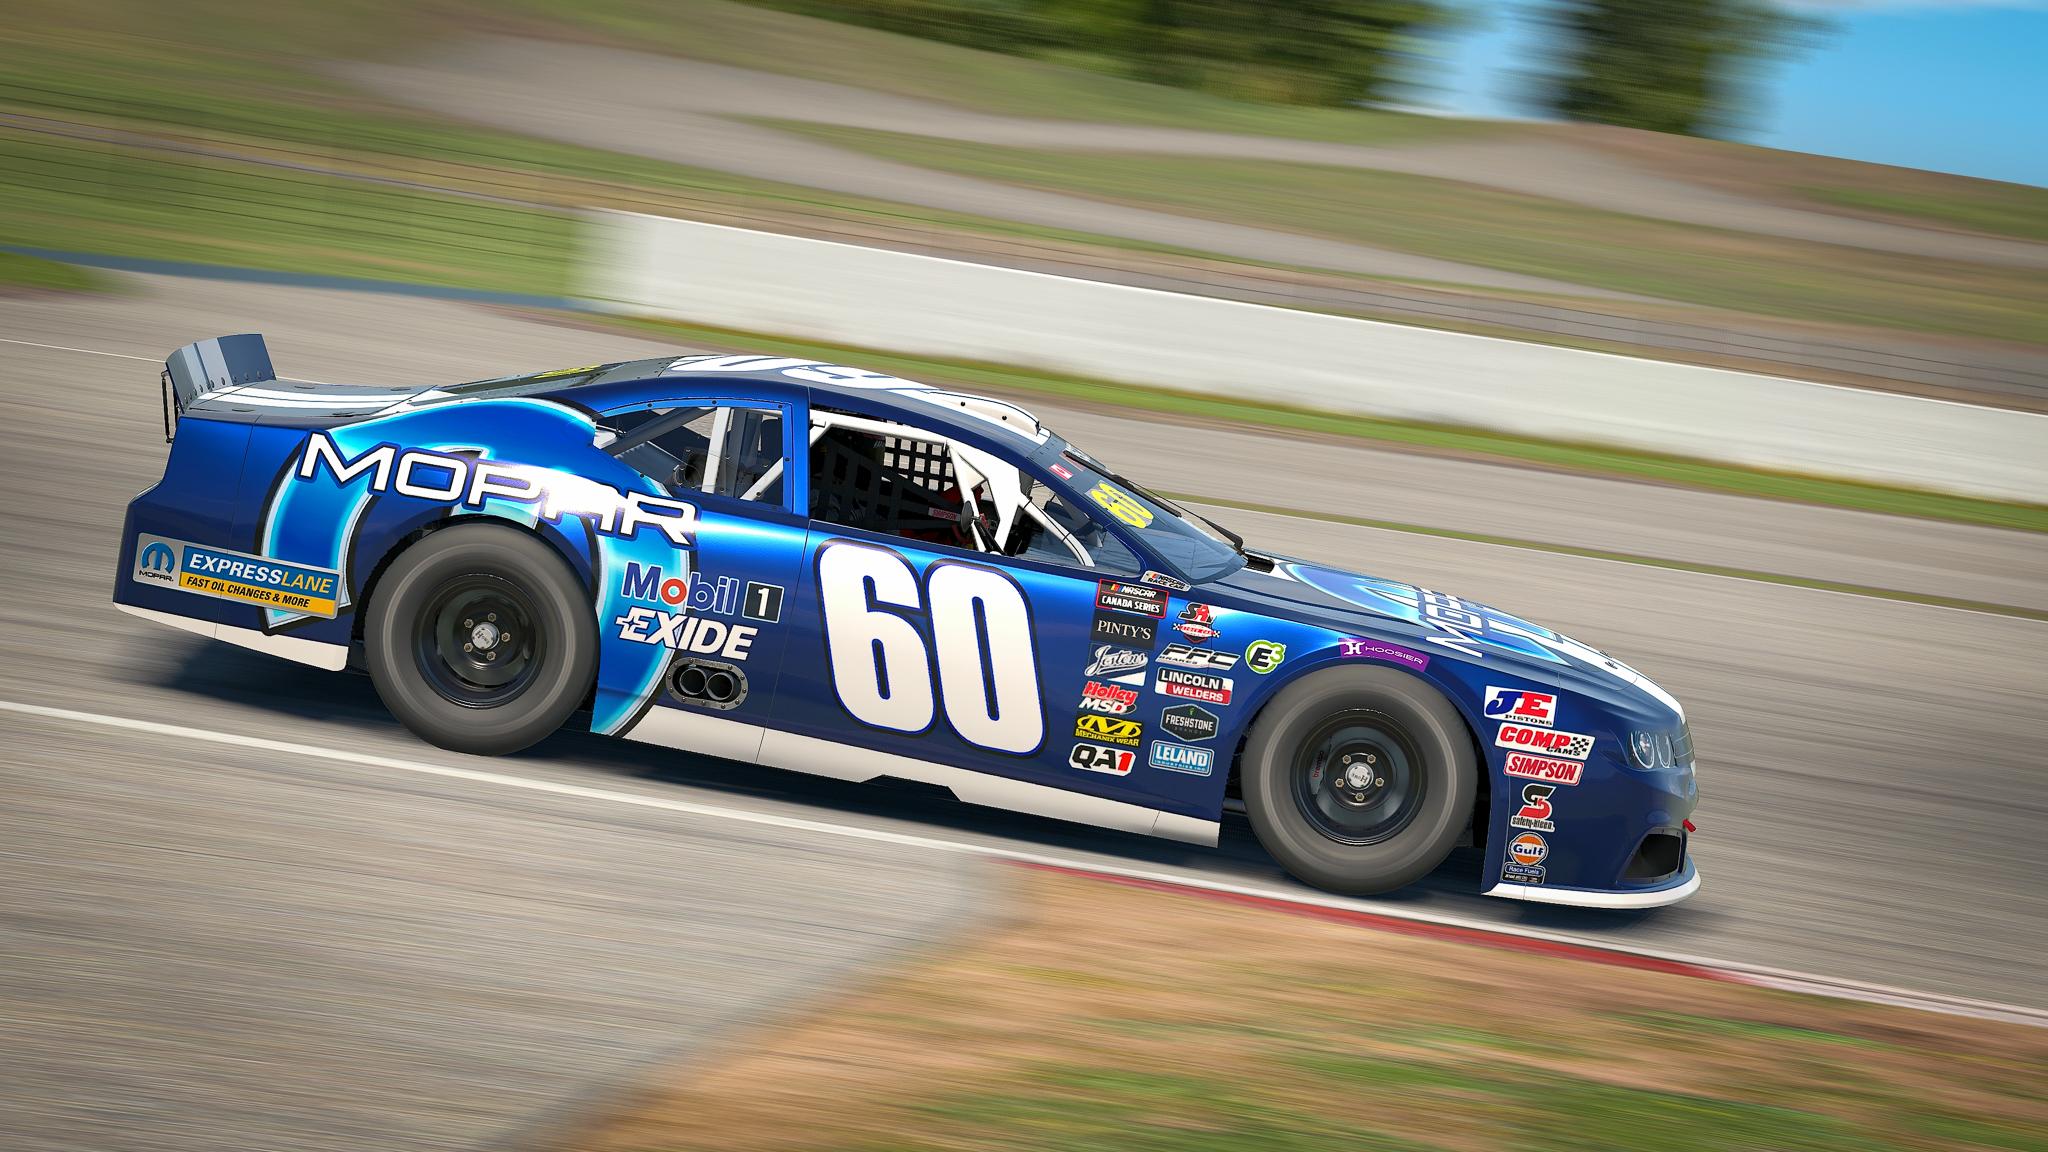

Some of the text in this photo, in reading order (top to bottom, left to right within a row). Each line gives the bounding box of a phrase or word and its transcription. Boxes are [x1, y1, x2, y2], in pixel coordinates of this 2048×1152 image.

[299, 432, 698, 545] MOPAR
[1090, 483, 1154, 529] 60
[139, 569, 175, 582] MOPAR
[189, 553, 333, 594] EXPRESSLANE
[1147, 577, 1168, 586] RACE
[186, 576, 311, 609] FAST OIL CHANGES & MORE
[621, 561, 740, 615] Mobil
[1121, 586, 1157, 599] NASCAR
[1101, 595, 1161, 614] CANADA SERIES
[616, 606, 759, 660] EXIDE
[1096, 620, 1152, 640] PINTY'S
[819, 542, 1044, 753] 60
[1162, 643, 1240, 667] PFC
[1365, 646, 1424, 665] HOOSIER
[1161, 670, 1220, 690] LINCOLN
[1081, 681, 1139, 706] Holley
[1171, 685, 1224, 702] WELDERS
[1078, 697, 1129, 715] MSD
[1485, 690, 1553, 719] JE
[1164, 714, 1214, 732] FRESHSTONE
[1504, 714, 1553, 726] PISTONS
[1075, 728, 1140, 747] MECHANIX WEAR
[1500, 726, 1572, 750] COMP
[1072, 744, 1134, 772] QA1
[1155, 745, 1209, 767] LELAND
[1546, 746, 1581, 757] CAMS
[1508, 756, 1578, 781] SIMPSON
[1512, 843, 1545, 856] Gulf
[1508, 865, 1540, 875] Race Fuels
